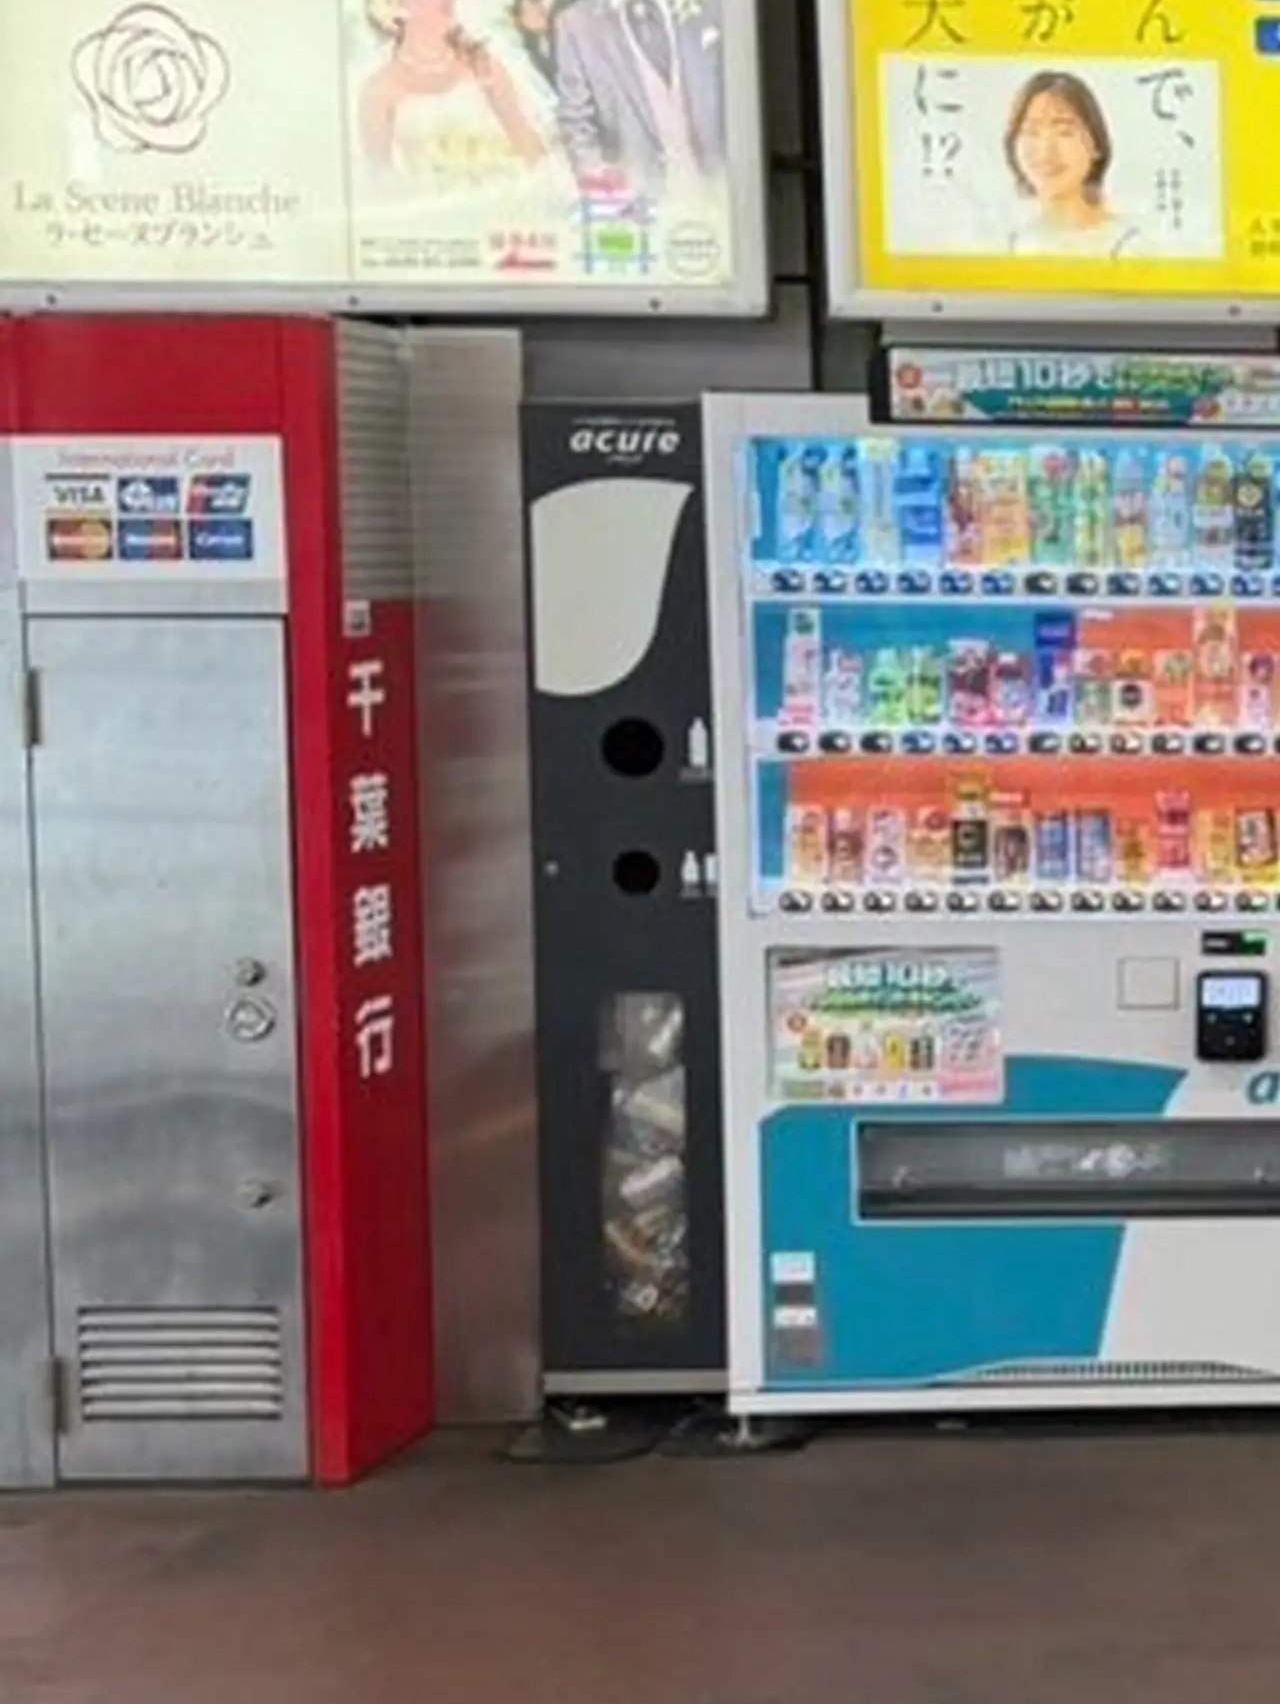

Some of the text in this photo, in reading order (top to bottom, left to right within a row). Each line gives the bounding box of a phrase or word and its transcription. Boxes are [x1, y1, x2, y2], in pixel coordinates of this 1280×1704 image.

[13, 179, 54, 212] La
[172, 180, 301, 215] Blanche
[569, 428, 681, 455] acure
[53, 484, 106, 503] VISA
[346, 659, 394, 1079] 千葉銀行
